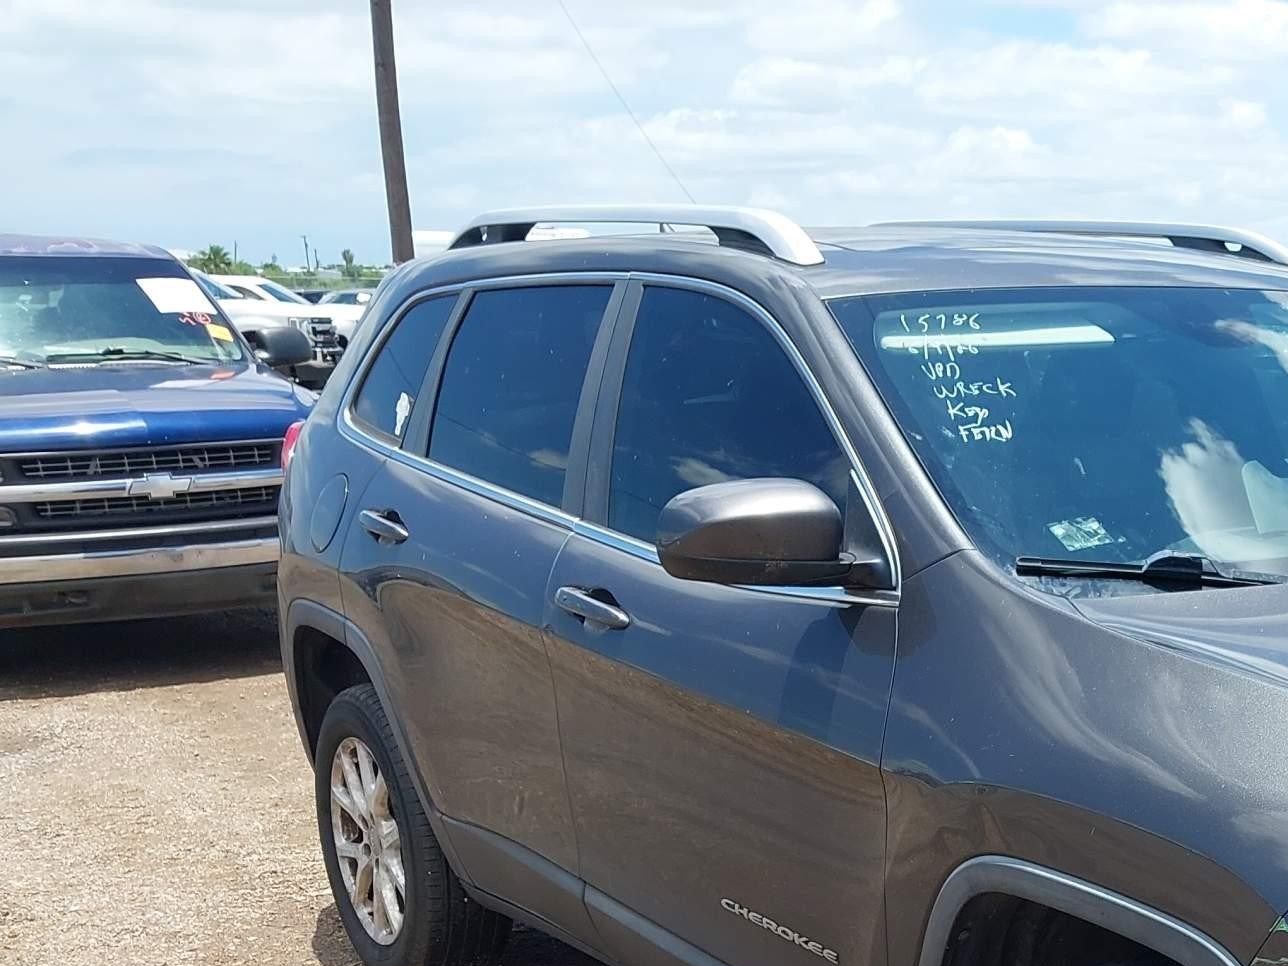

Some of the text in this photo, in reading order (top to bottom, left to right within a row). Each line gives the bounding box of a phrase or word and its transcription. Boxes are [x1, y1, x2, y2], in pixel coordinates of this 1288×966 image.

[901, 313, 980, 333] 15786
[933, 377, 1017, 399] WRECK
[720, 898, 839, 965] CHEROKEE
